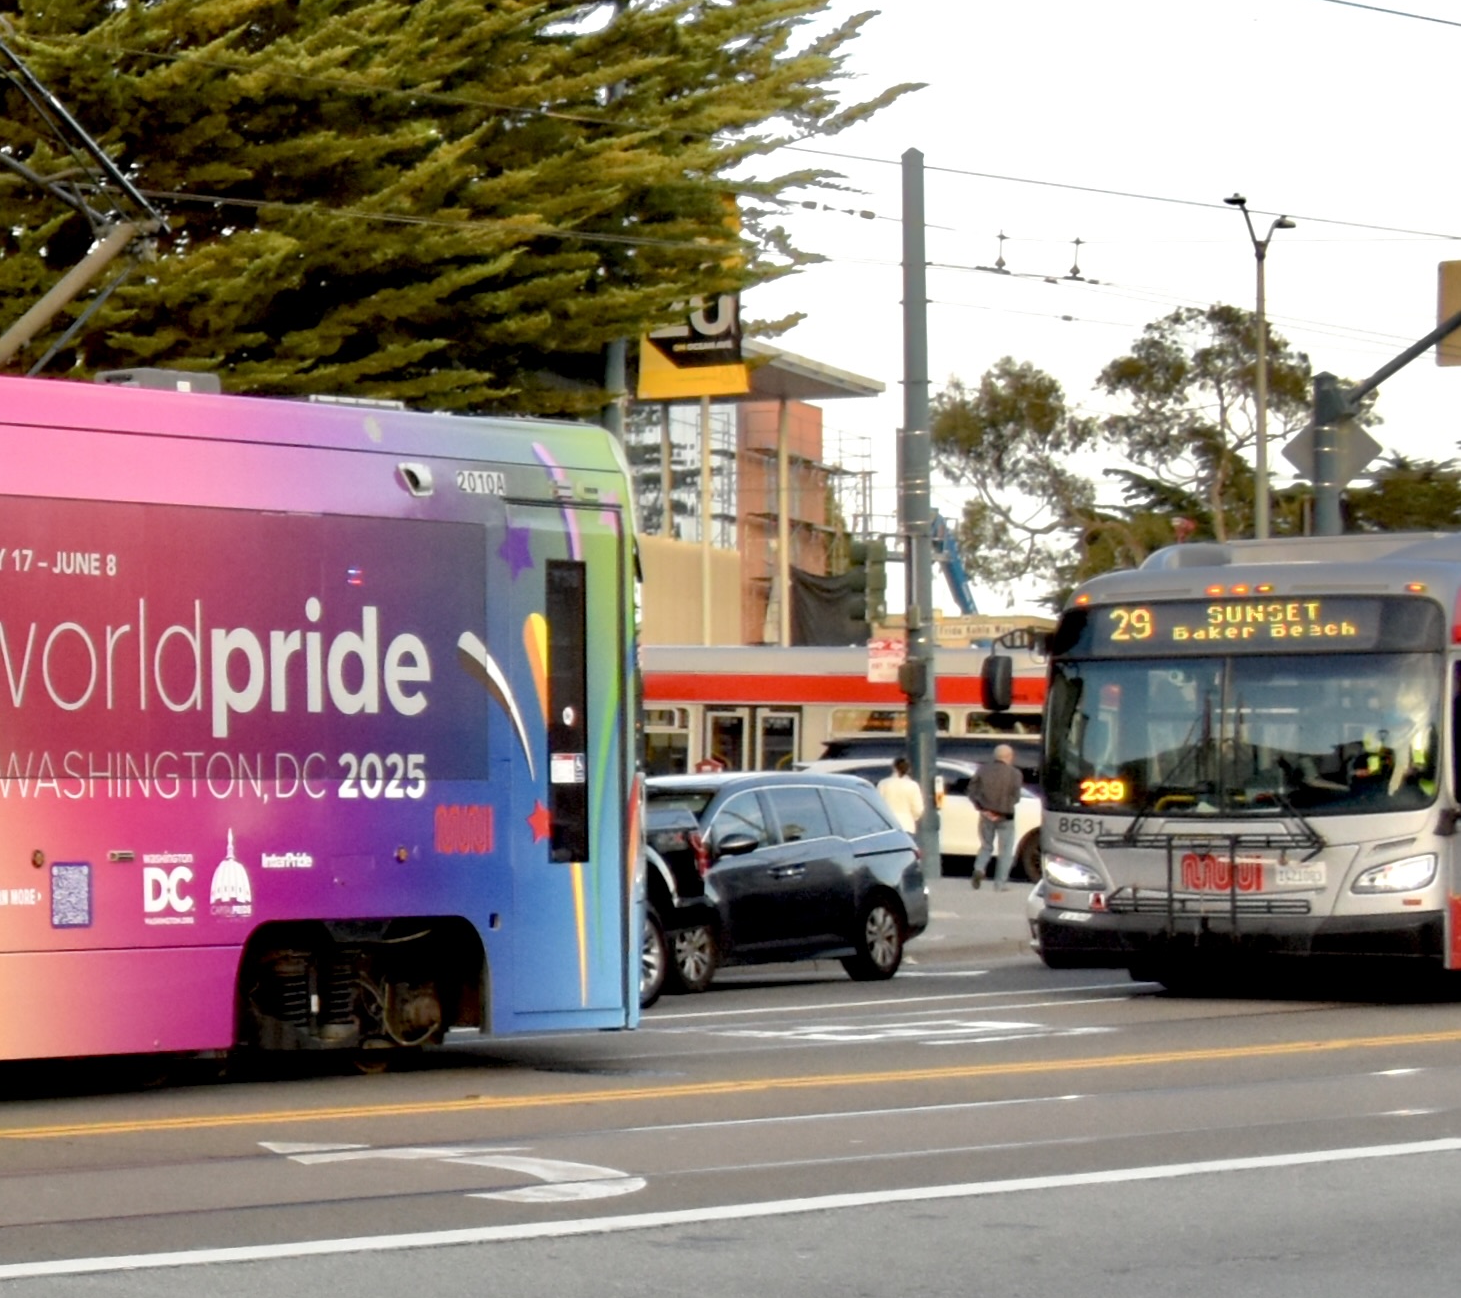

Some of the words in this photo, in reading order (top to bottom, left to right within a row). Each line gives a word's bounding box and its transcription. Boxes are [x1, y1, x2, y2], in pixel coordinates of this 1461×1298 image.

[457, 471, 505, 494] 2010A
[11, 549, 34, 572] 17
[53, 551, 101, 576] JUNE
[106, 554, 117, 577] 8
[1109, 608, 1152, 641] 29
[1206, 603, 1321, 623] SUNSET
[1172, 625, 1255, 641] Baker
[1270, 622, 1356, 638] Beach
[338, 753, 427, 800] 2025
[1080, 779, 1125, 802] 239
[1058, 817, 1105, 835] 8631
[11, 888, 36, 905] MORE
[143, 866, 193, 913] DC
